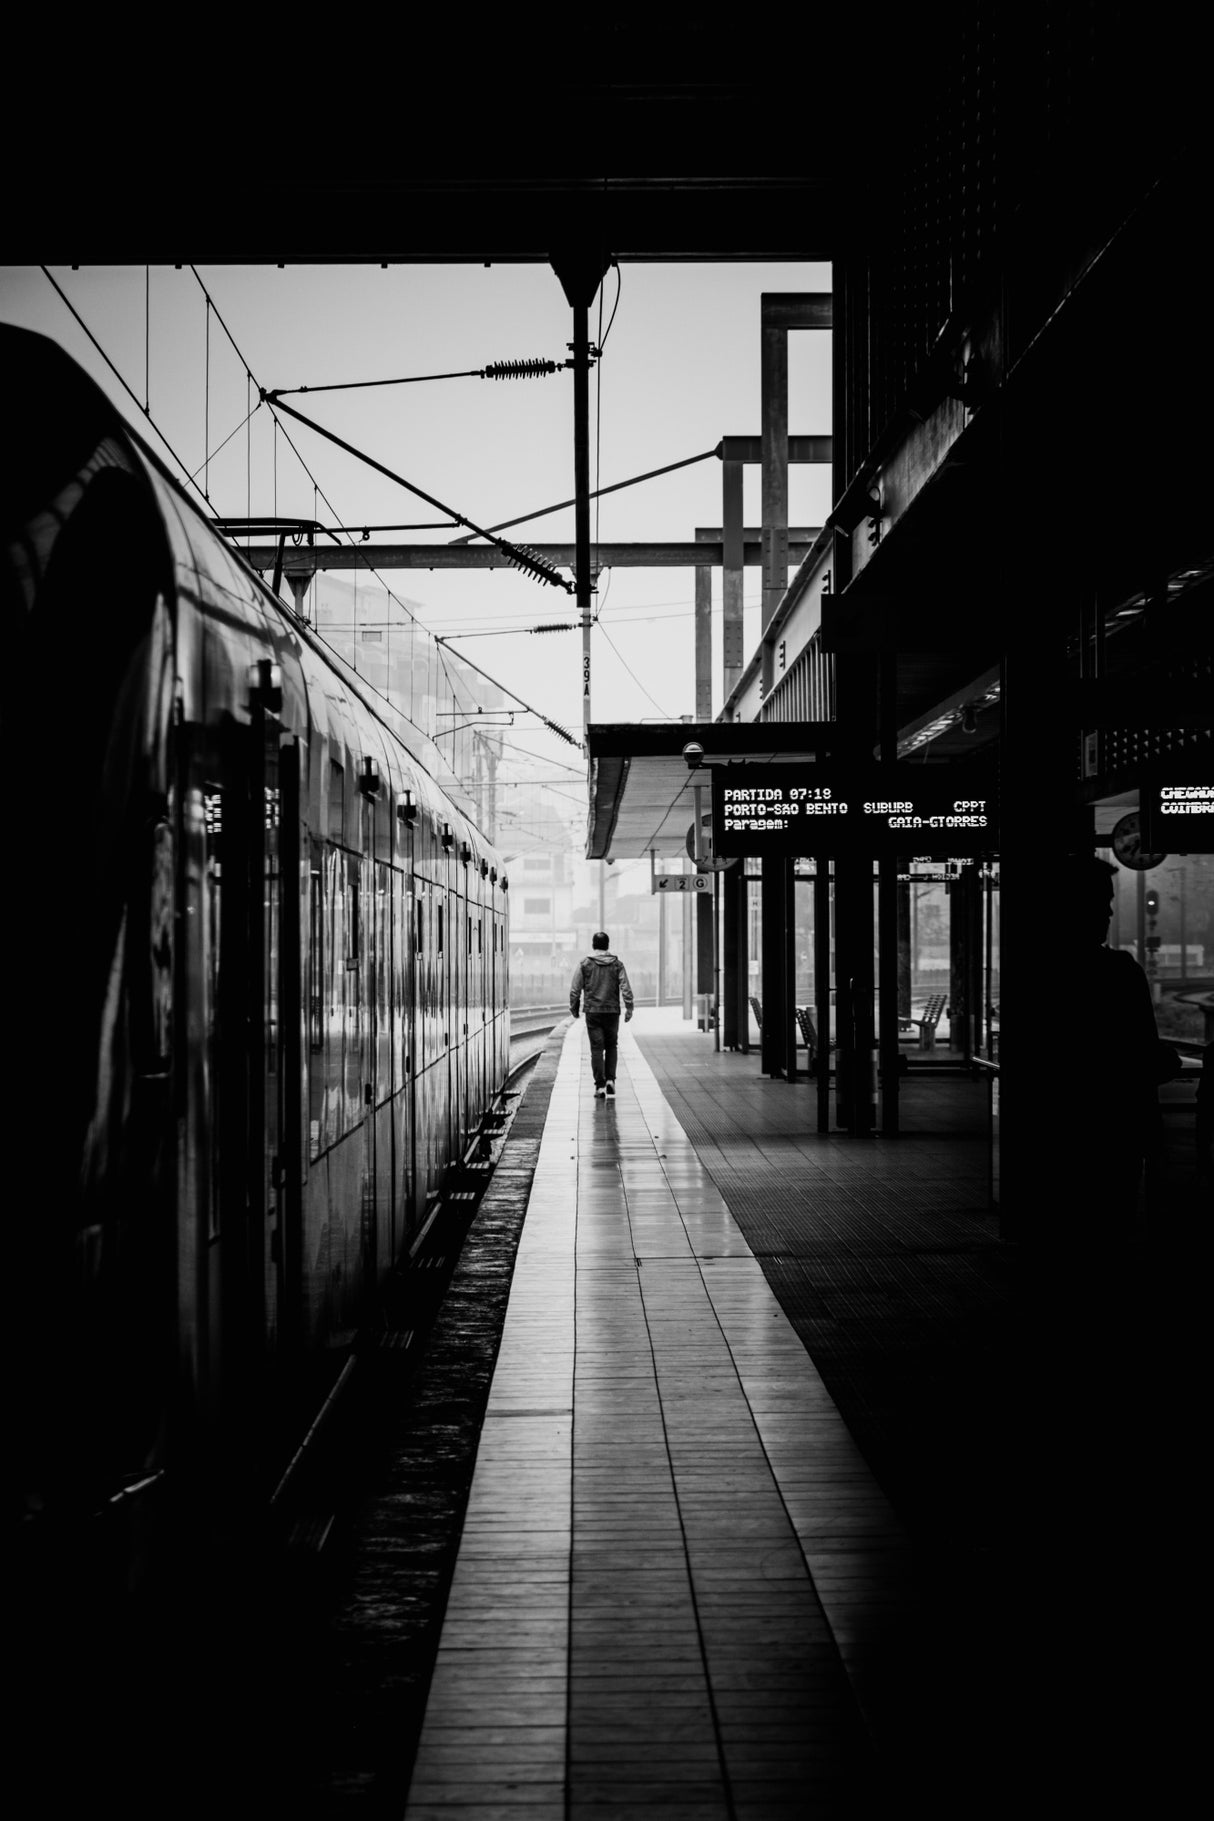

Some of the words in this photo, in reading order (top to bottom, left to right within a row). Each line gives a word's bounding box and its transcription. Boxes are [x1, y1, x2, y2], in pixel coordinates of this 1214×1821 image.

[724, 788, 783, 802] PARTIDA
[789, 787, 832, 800] 07:18
[724, 802, 800, 817] PORTO-SÃO
[805, 802, 849, 815] BENTO
[863, 801, 914, 814] SUBURB
[953, 800, 987, 813] CPPT
[724, 818, 789, 831] Paragem:
[887, 815, 988, 829] GAIA-GTORRES
[679, 880, 686, 890] 2
[695, 878, 705, 888] G
